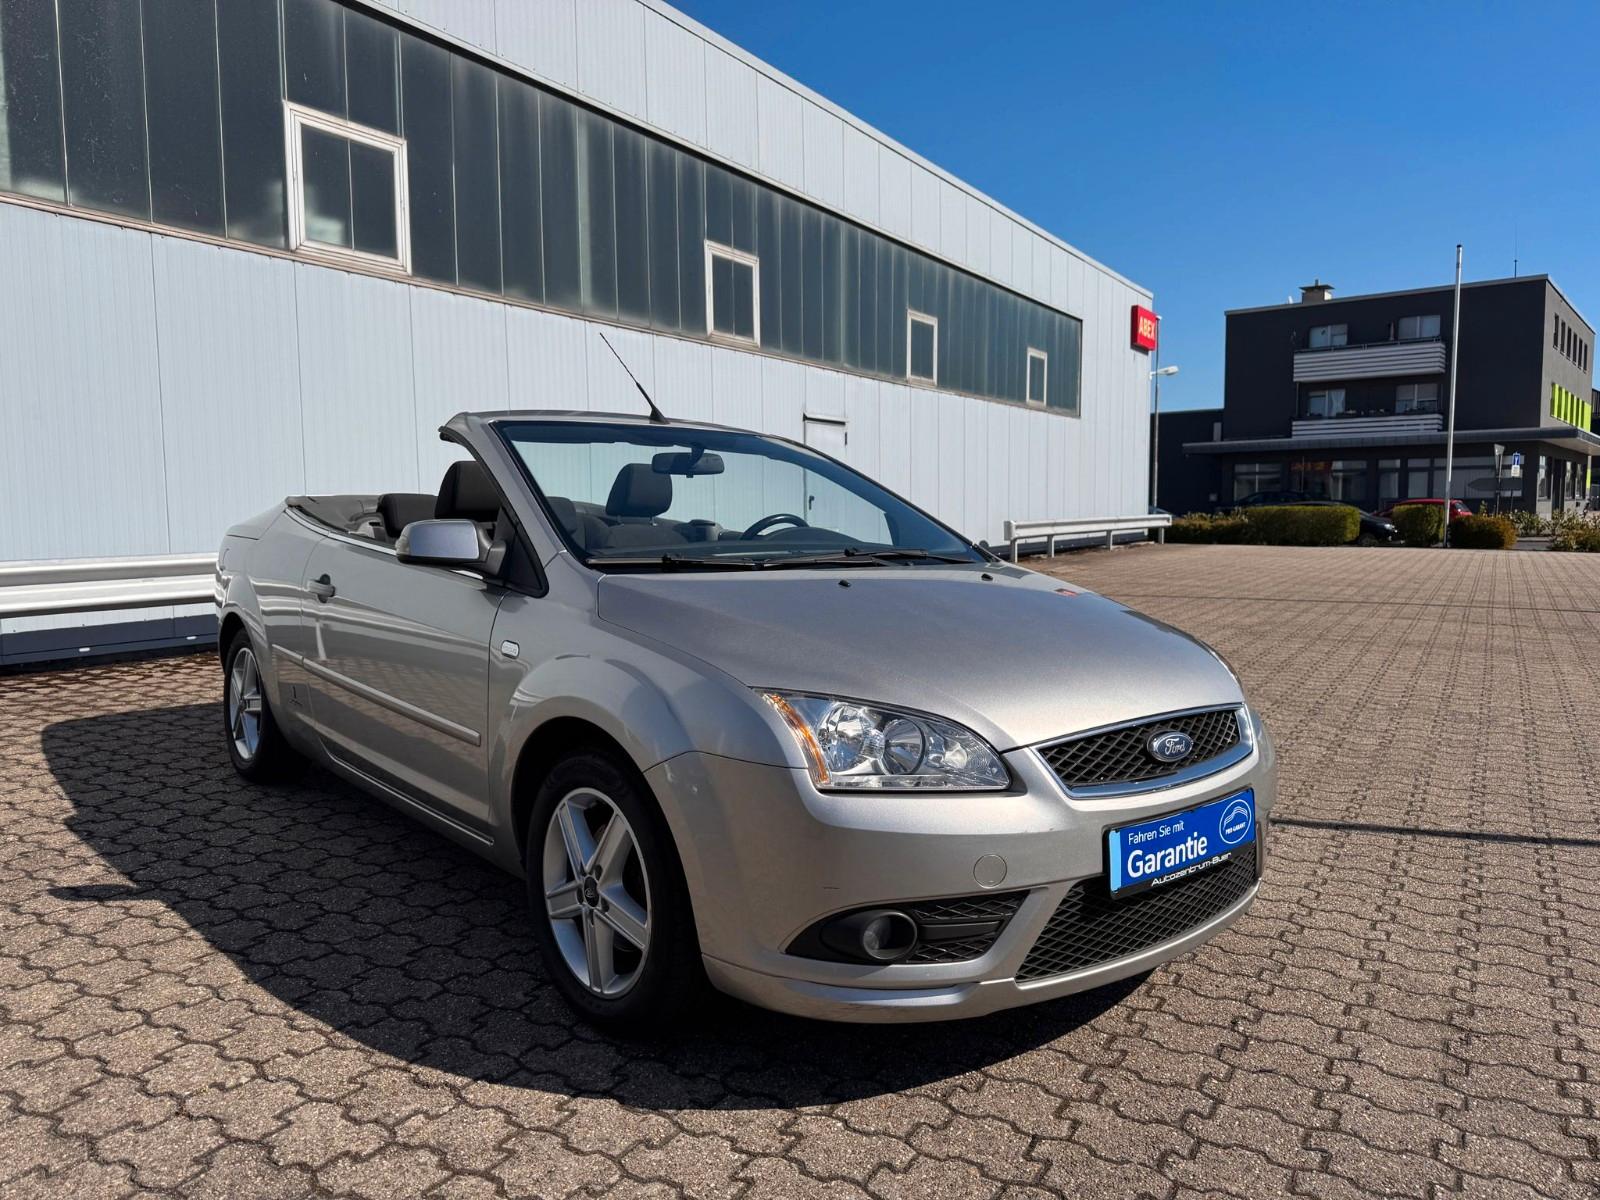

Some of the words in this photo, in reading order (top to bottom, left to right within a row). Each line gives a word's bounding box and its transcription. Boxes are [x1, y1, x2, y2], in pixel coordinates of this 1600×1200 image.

[1165, 738, 1185, 755] Ford
[1128, 831, 1157, 846] Fahren
[1159, 826, 1171, 838] Sie
[1173, 820, 1184, 834] mit
[1127, 832, 1208, 878] Garantie
[1151, 852, 1231, 887] Autozentrum-Buer
